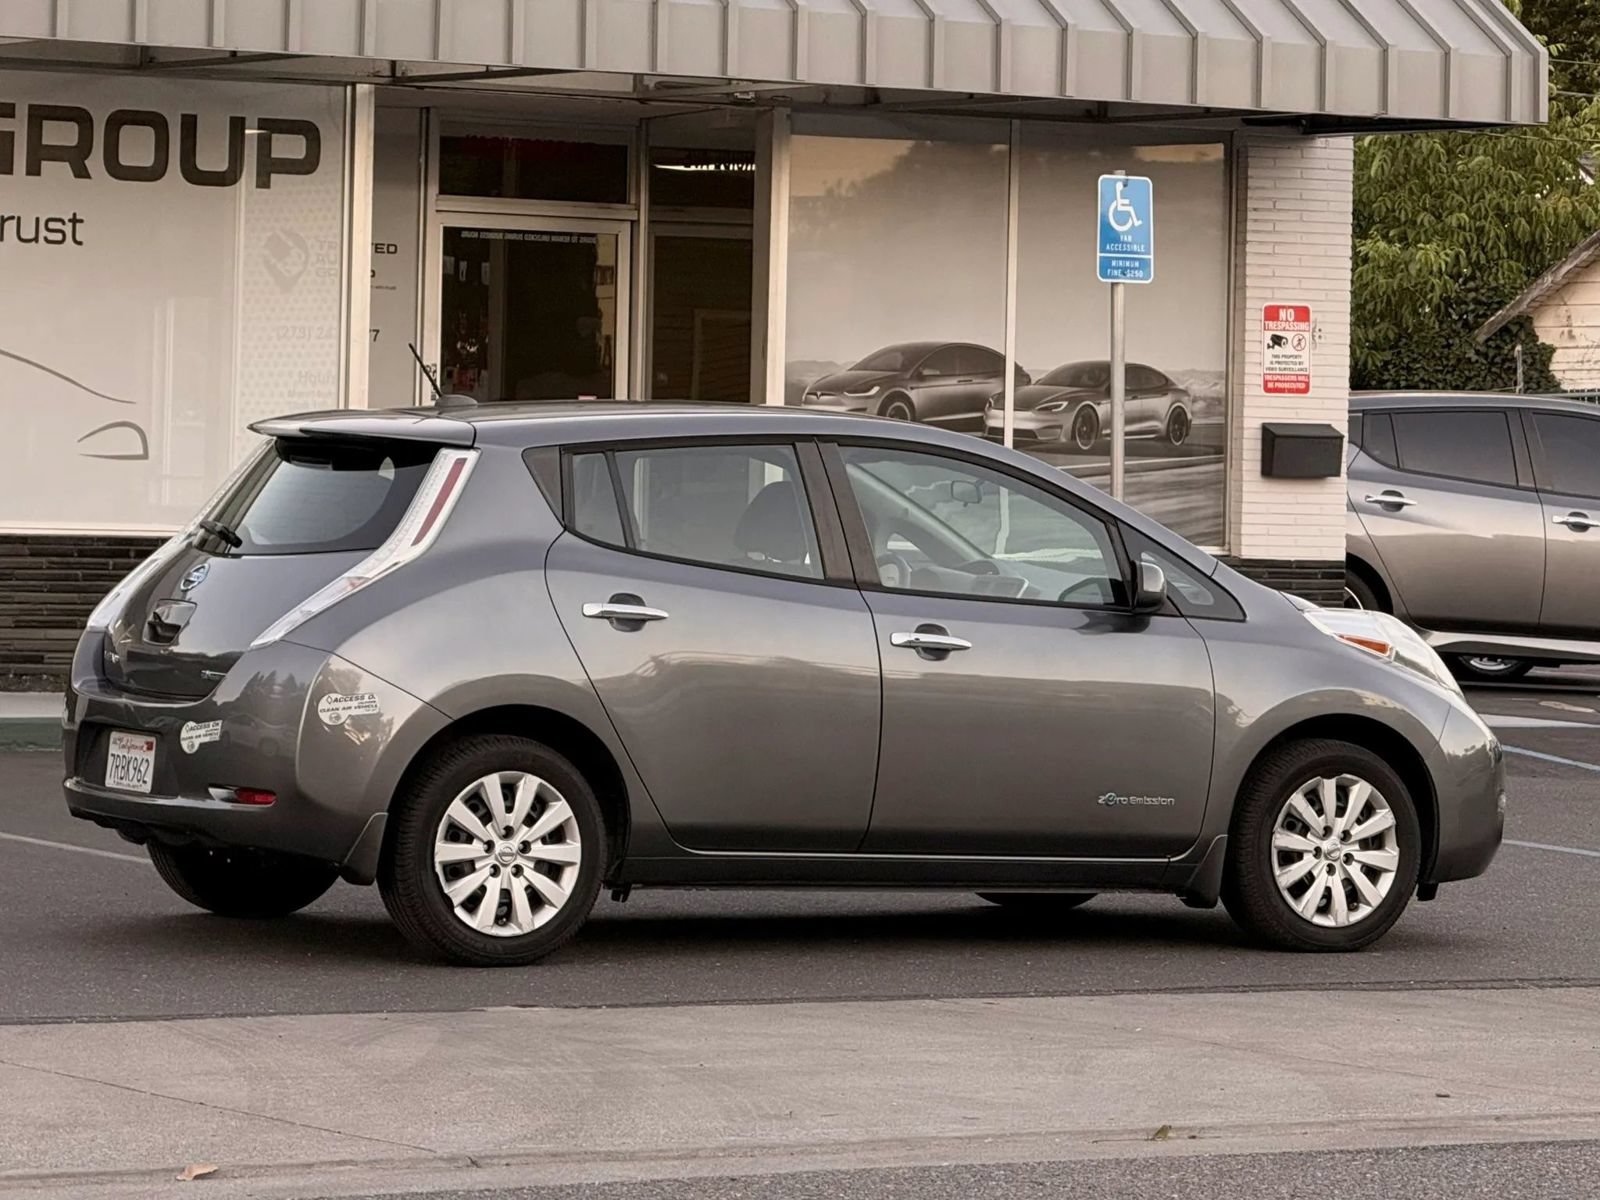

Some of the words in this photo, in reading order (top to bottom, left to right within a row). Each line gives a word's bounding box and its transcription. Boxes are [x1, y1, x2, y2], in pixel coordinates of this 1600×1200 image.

[0, 102, 322, 189] ROUP
[1105, 243, 1146, 252] ACCESSIBLE
[1279, 308, 1295, 321] NO
[1264, 321, 1310, 331] TRESPASSING
[333, 695, 366, 703] ACCESS
[109, 752, 150, 785] 7RBK962
